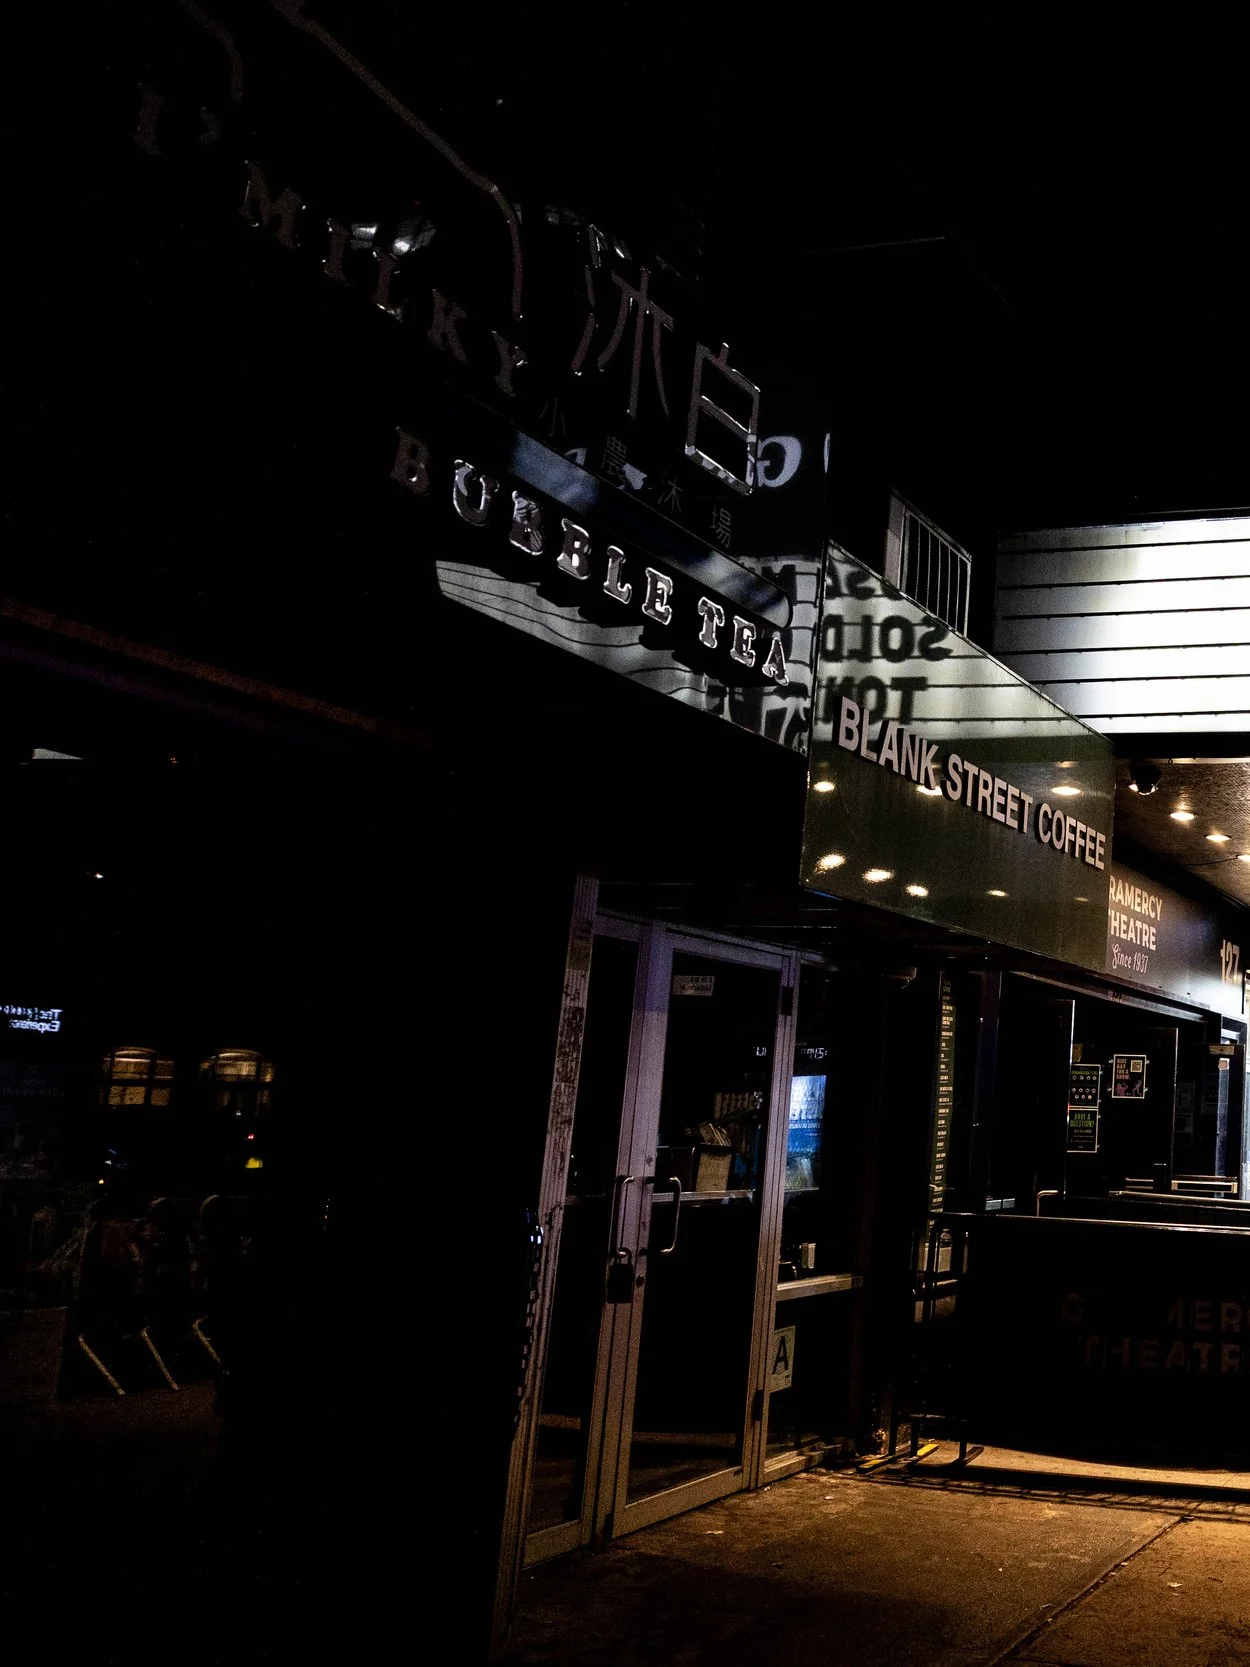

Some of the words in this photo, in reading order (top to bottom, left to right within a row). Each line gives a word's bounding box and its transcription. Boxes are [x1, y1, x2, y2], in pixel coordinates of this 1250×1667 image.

[387, 421, 683, 626] BUBBLE
[697, 595, 790, 687] TEA
[838, 695, 940, 789] BLANK
[946, 753, 1034, 833] STREET
[1038, 803, 1107, 871] COFFEE
[1112, 943, 1132, 970] Since
[1133, 951, 1149, 974] 1937
[1220, 939, 1240, 985] 127
[771, 1335, 789, 1375] A
